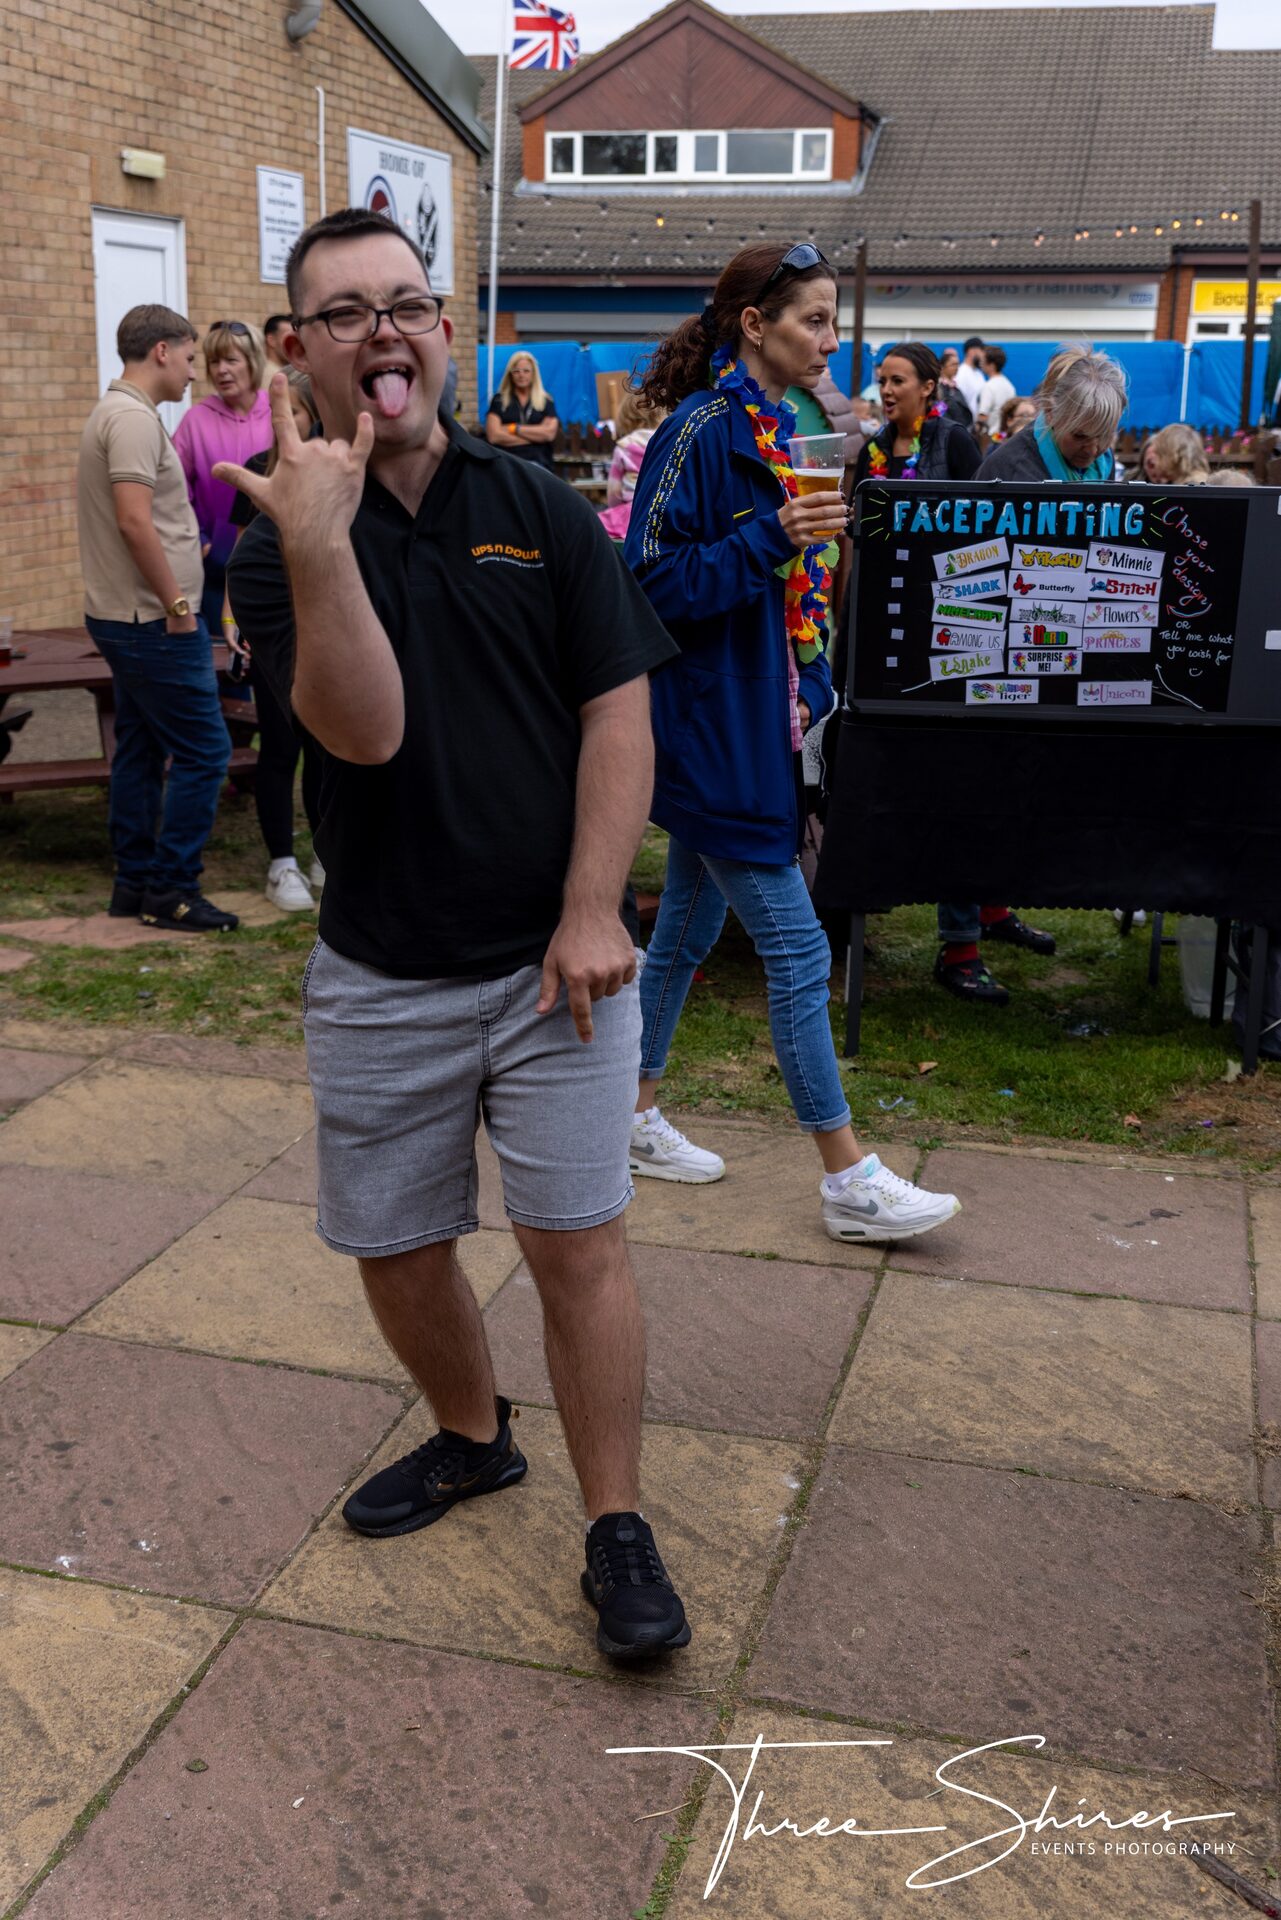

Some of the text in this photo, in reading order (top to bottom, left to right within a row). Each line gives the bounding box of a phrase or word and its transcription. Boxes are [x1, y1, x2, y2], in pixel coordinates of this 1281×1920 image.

[1162, 506, 1208, 549] Chose
[1111, 552, 1153, 571] Minnie
[1174, 549, 1214, 573] your
[954, 579, 1001, 597] SHARK
[1039, 584, 1075, 593] Butterfly
[1172, 568, 1208, 606] design
[935, 604, 1004, 623] MINECRAFT
[988, 635, 1001, 649] US
[1160, 630, 1234, 645] Tell me what
[953, 653, 991, 674] Snake
[1027, 652, 1063, 662] SURPRISE
[1166, 644, 1231, 666] you wish for
[1038, 662, 1052, 672] ME!
[999, 692, 1031, 702] Tiger
[1100, 684, 1145, 703] Unicorn
